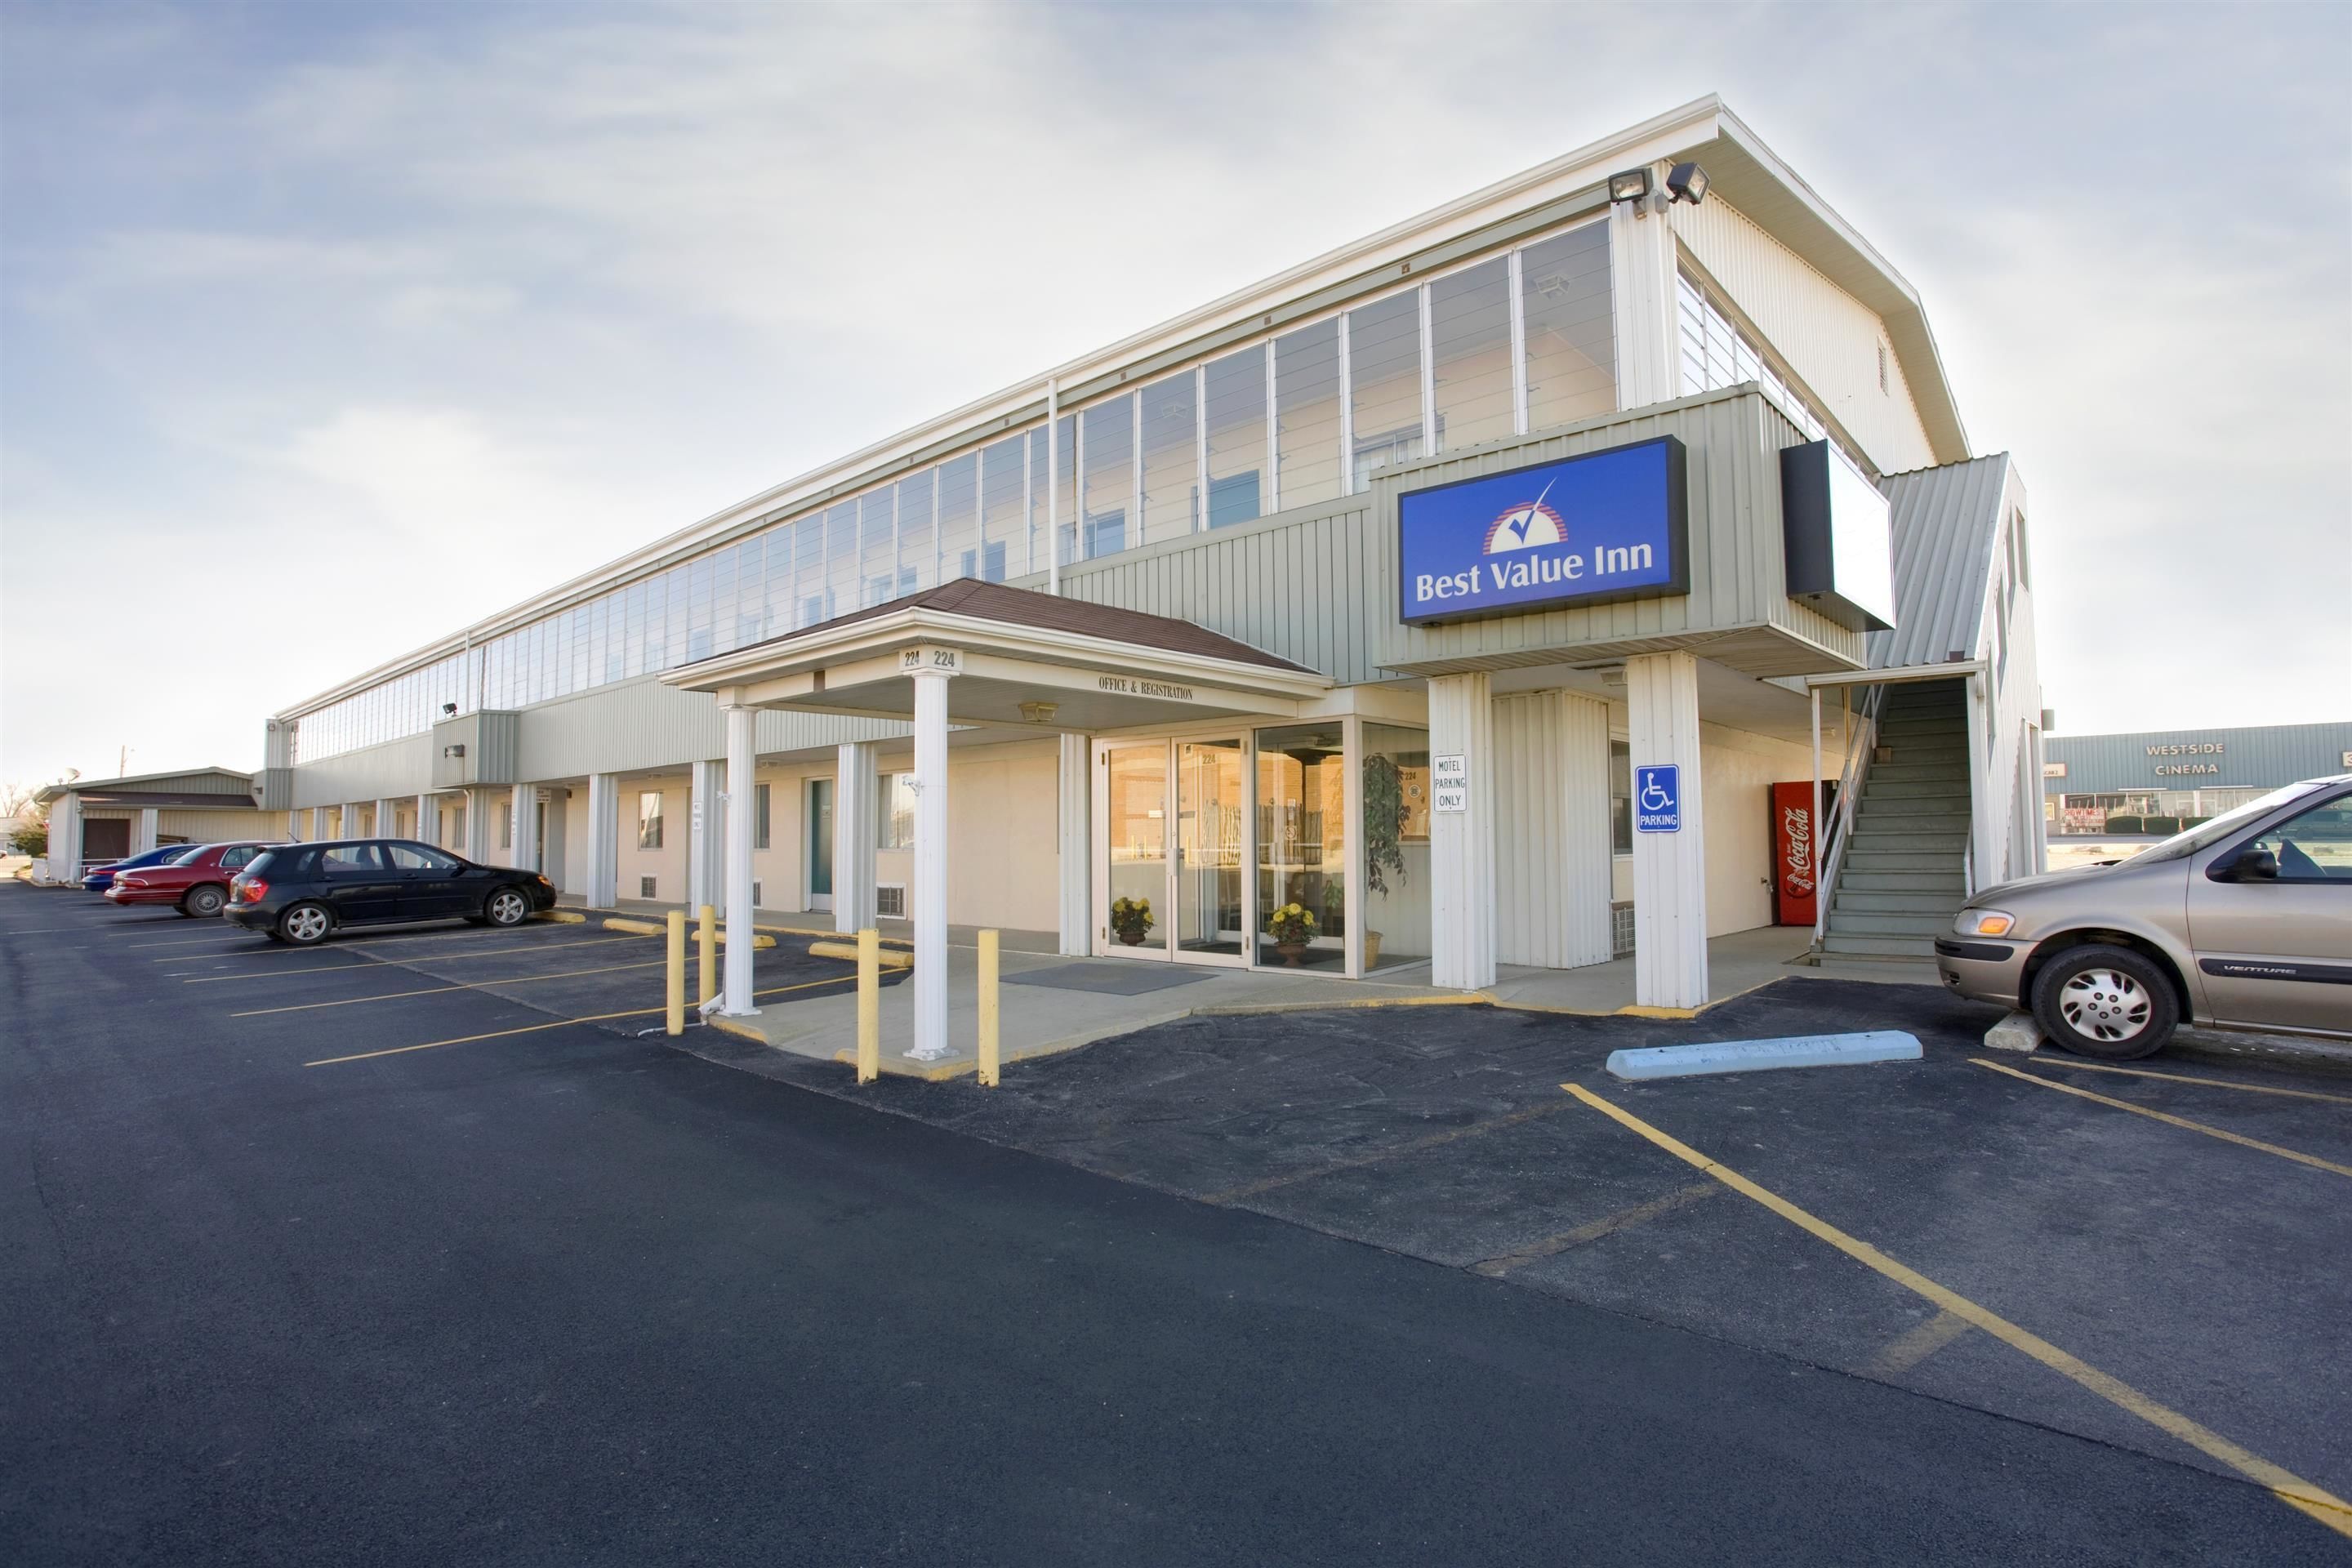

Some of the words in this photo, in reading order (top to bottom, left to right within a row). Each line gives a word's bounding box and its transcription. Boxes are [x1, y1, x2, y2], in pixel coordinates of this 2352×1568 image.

[1417, 564, 1481, 602] Best
[1490, 555, 1584, 590] Value
[1594, 542, 1652, 575] Inn
[905, 650, 920, 666] 224
[934, 650, 955, 667] 224
[1098, 676, 1127, 692] OFFICE
[1130, 680, 1137, 693] &
[1141, 681, 1192, 700] REGISTRATION
[2146, 743, 2224, 755] WESTSIDE
[1202, 754, 1216, 764] 224
[1438, 760, 1461, 772] MOTEL
[2155, 764, 2218, 775] CINEMA
[1405, 772, 1416, 781] 224
[1435, 777, 1465, 790] PARKING
[1439, 795, 1461, 806] ONLY
[1640, 814, 1677, 826] PARKING
[1785, 806, 1811, 871] Coca-Cola
[2224, 965, 2296, 974] VENTURE
